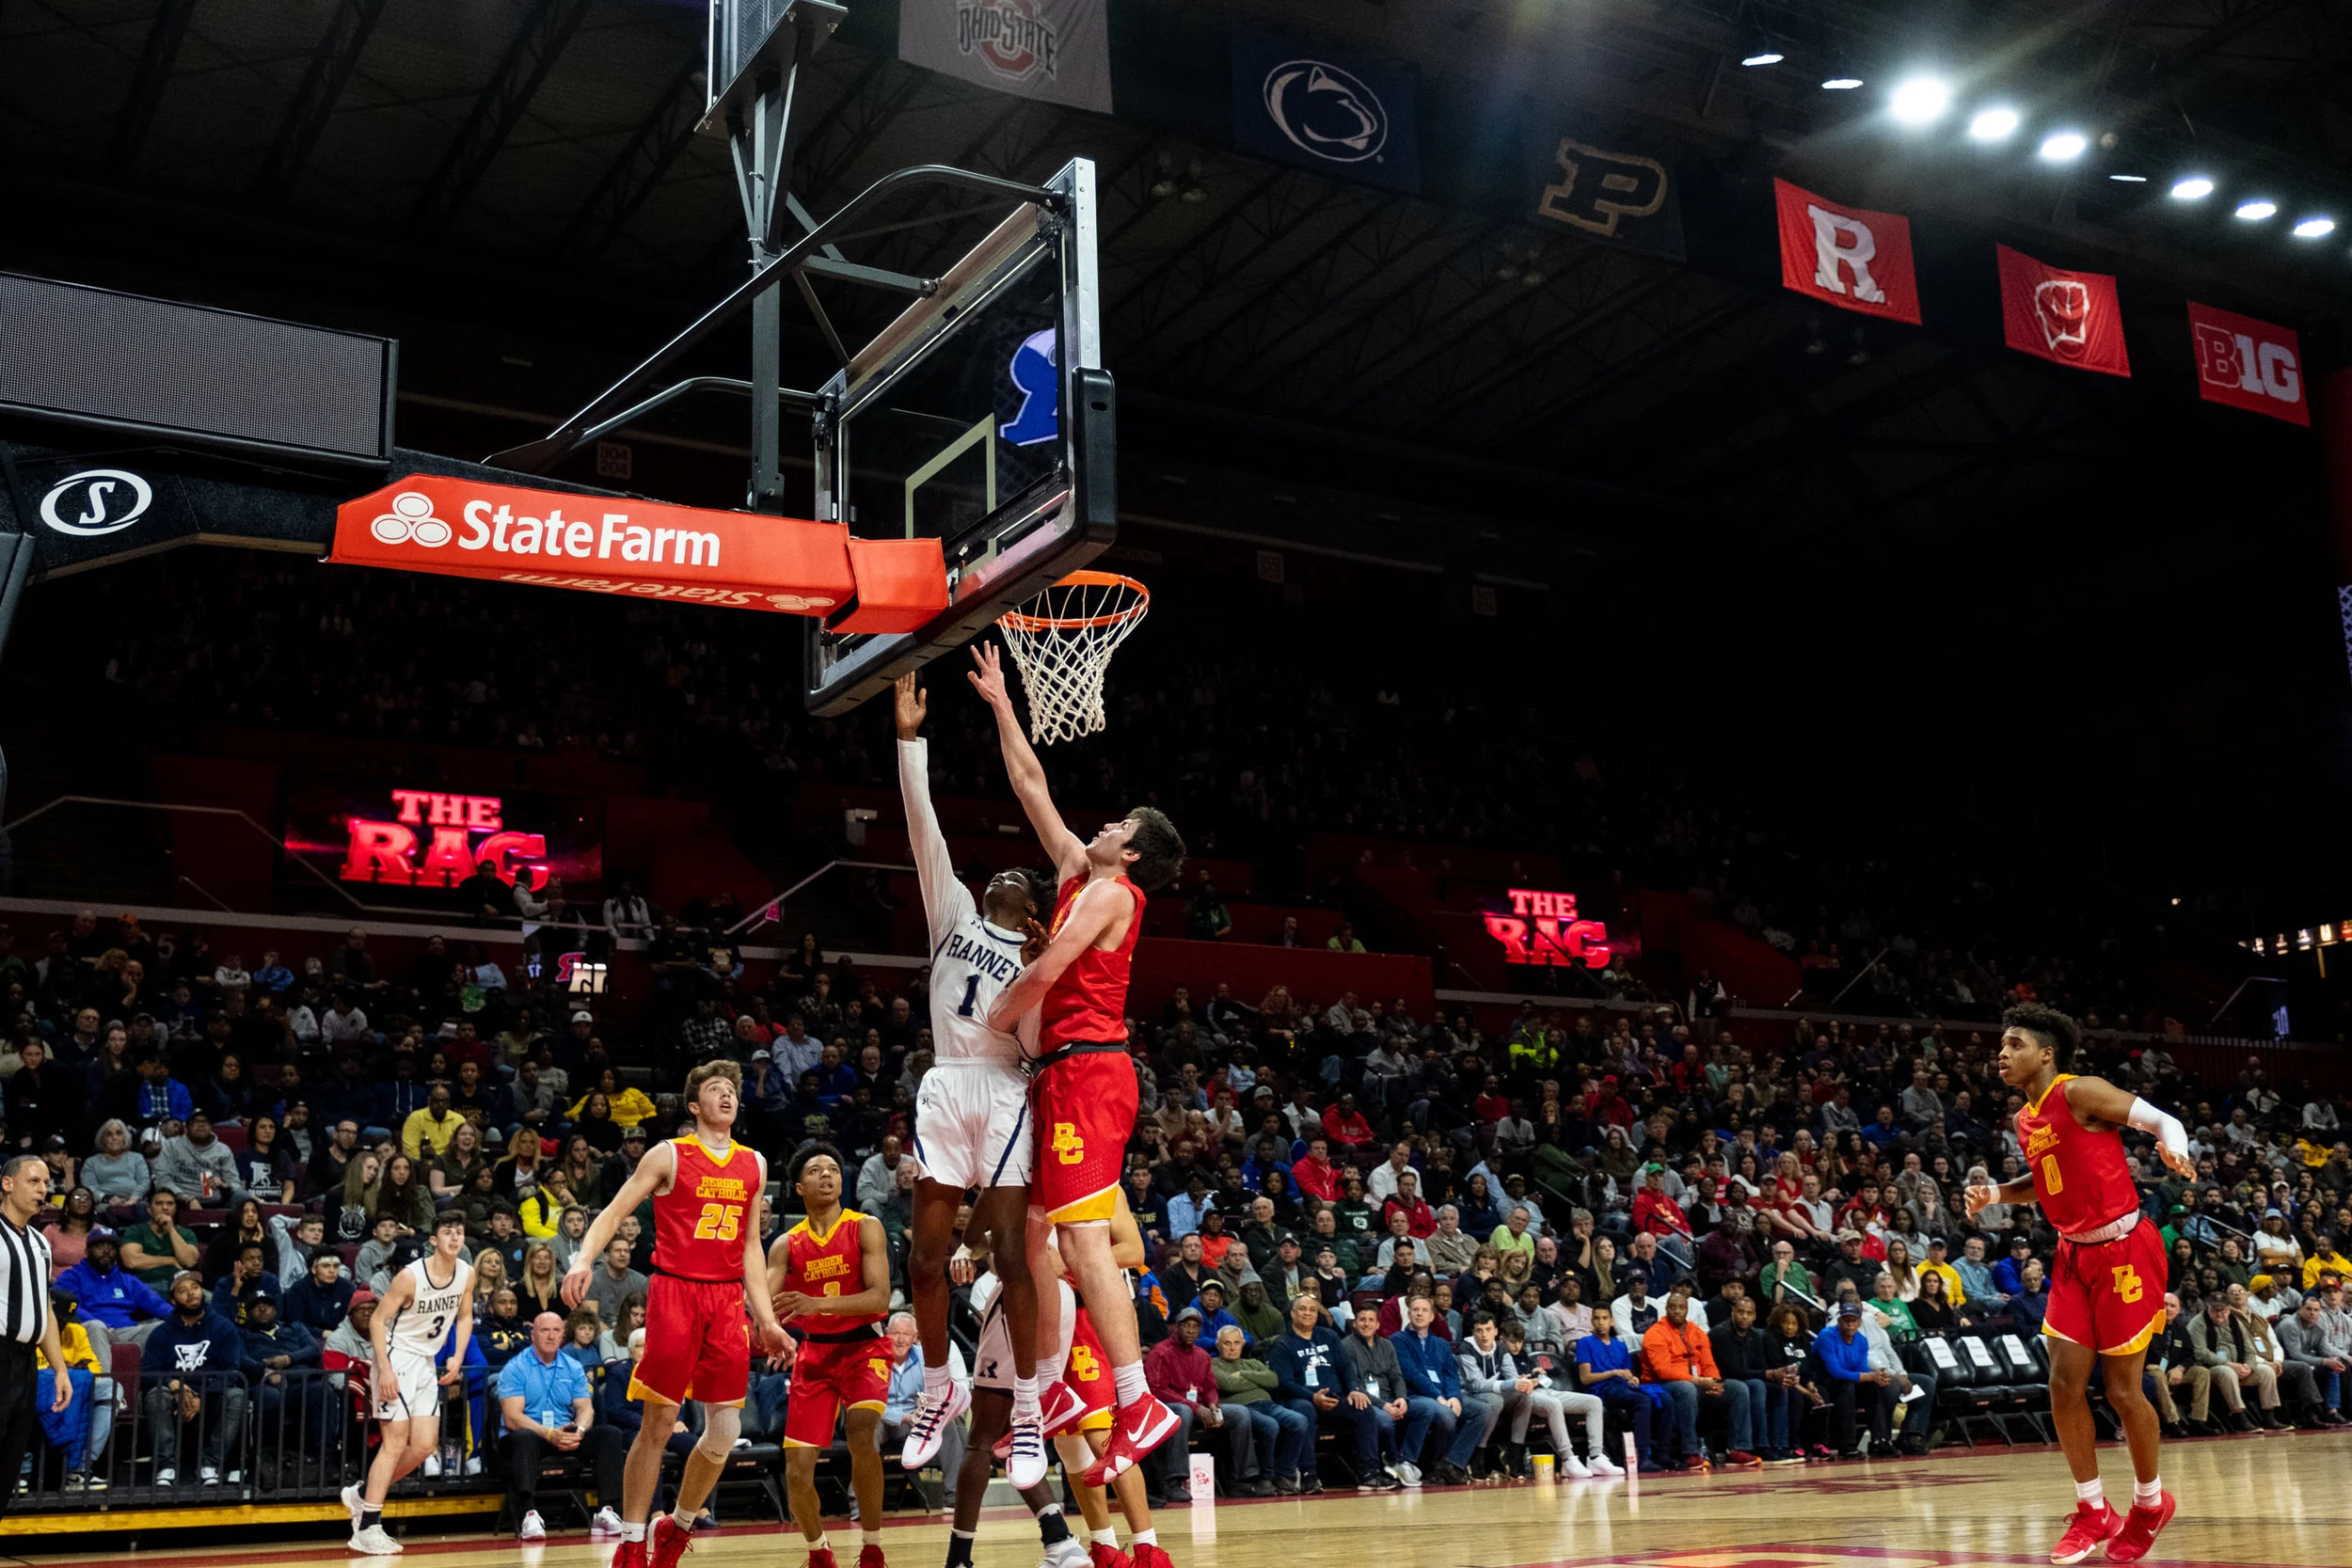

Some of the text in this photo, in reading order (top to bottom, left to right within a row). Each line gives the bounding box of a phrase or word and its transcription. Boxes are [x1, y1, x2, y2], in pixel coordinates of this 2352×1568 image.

[1807, 203, 1886, 304] R
[391, 788, 502, 832] THE
[1507, 888, 1580, 922] THE
[958, 974, 980, 1017] 1
[701, 1176, 744, 1191] BERGEN
[2041, 1153, 2064, 1196] 0
[695, 1185, 748, 1202] CATHOLIC
[693, 1203, 743, 1241] 25
[803, 1263, 850, 1282] CATHOLIC
[805, 1254, 844, 1271] BERGEN
[427, 1315, 446, 1339] 3
